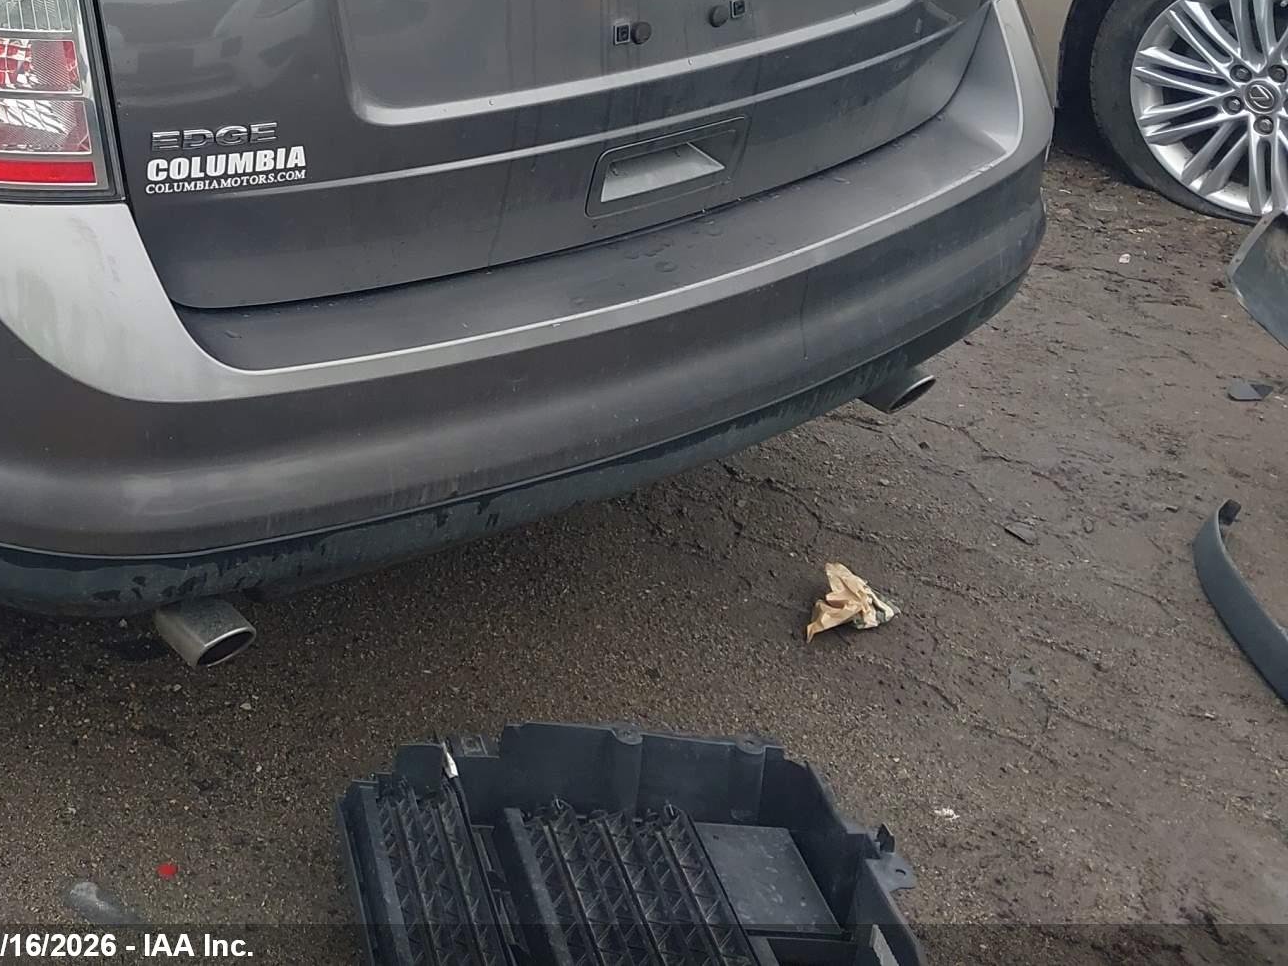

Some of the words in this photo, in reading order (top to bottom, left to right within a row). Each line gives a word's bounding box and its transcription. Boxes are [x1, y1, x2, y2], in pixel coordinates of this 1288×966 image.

[152, 122, 278, 151] EDGE
[146, 145, 307, 182] COLUMBIA
[145, 169, 307, 195] COLUMBIAMOTORS.COM
